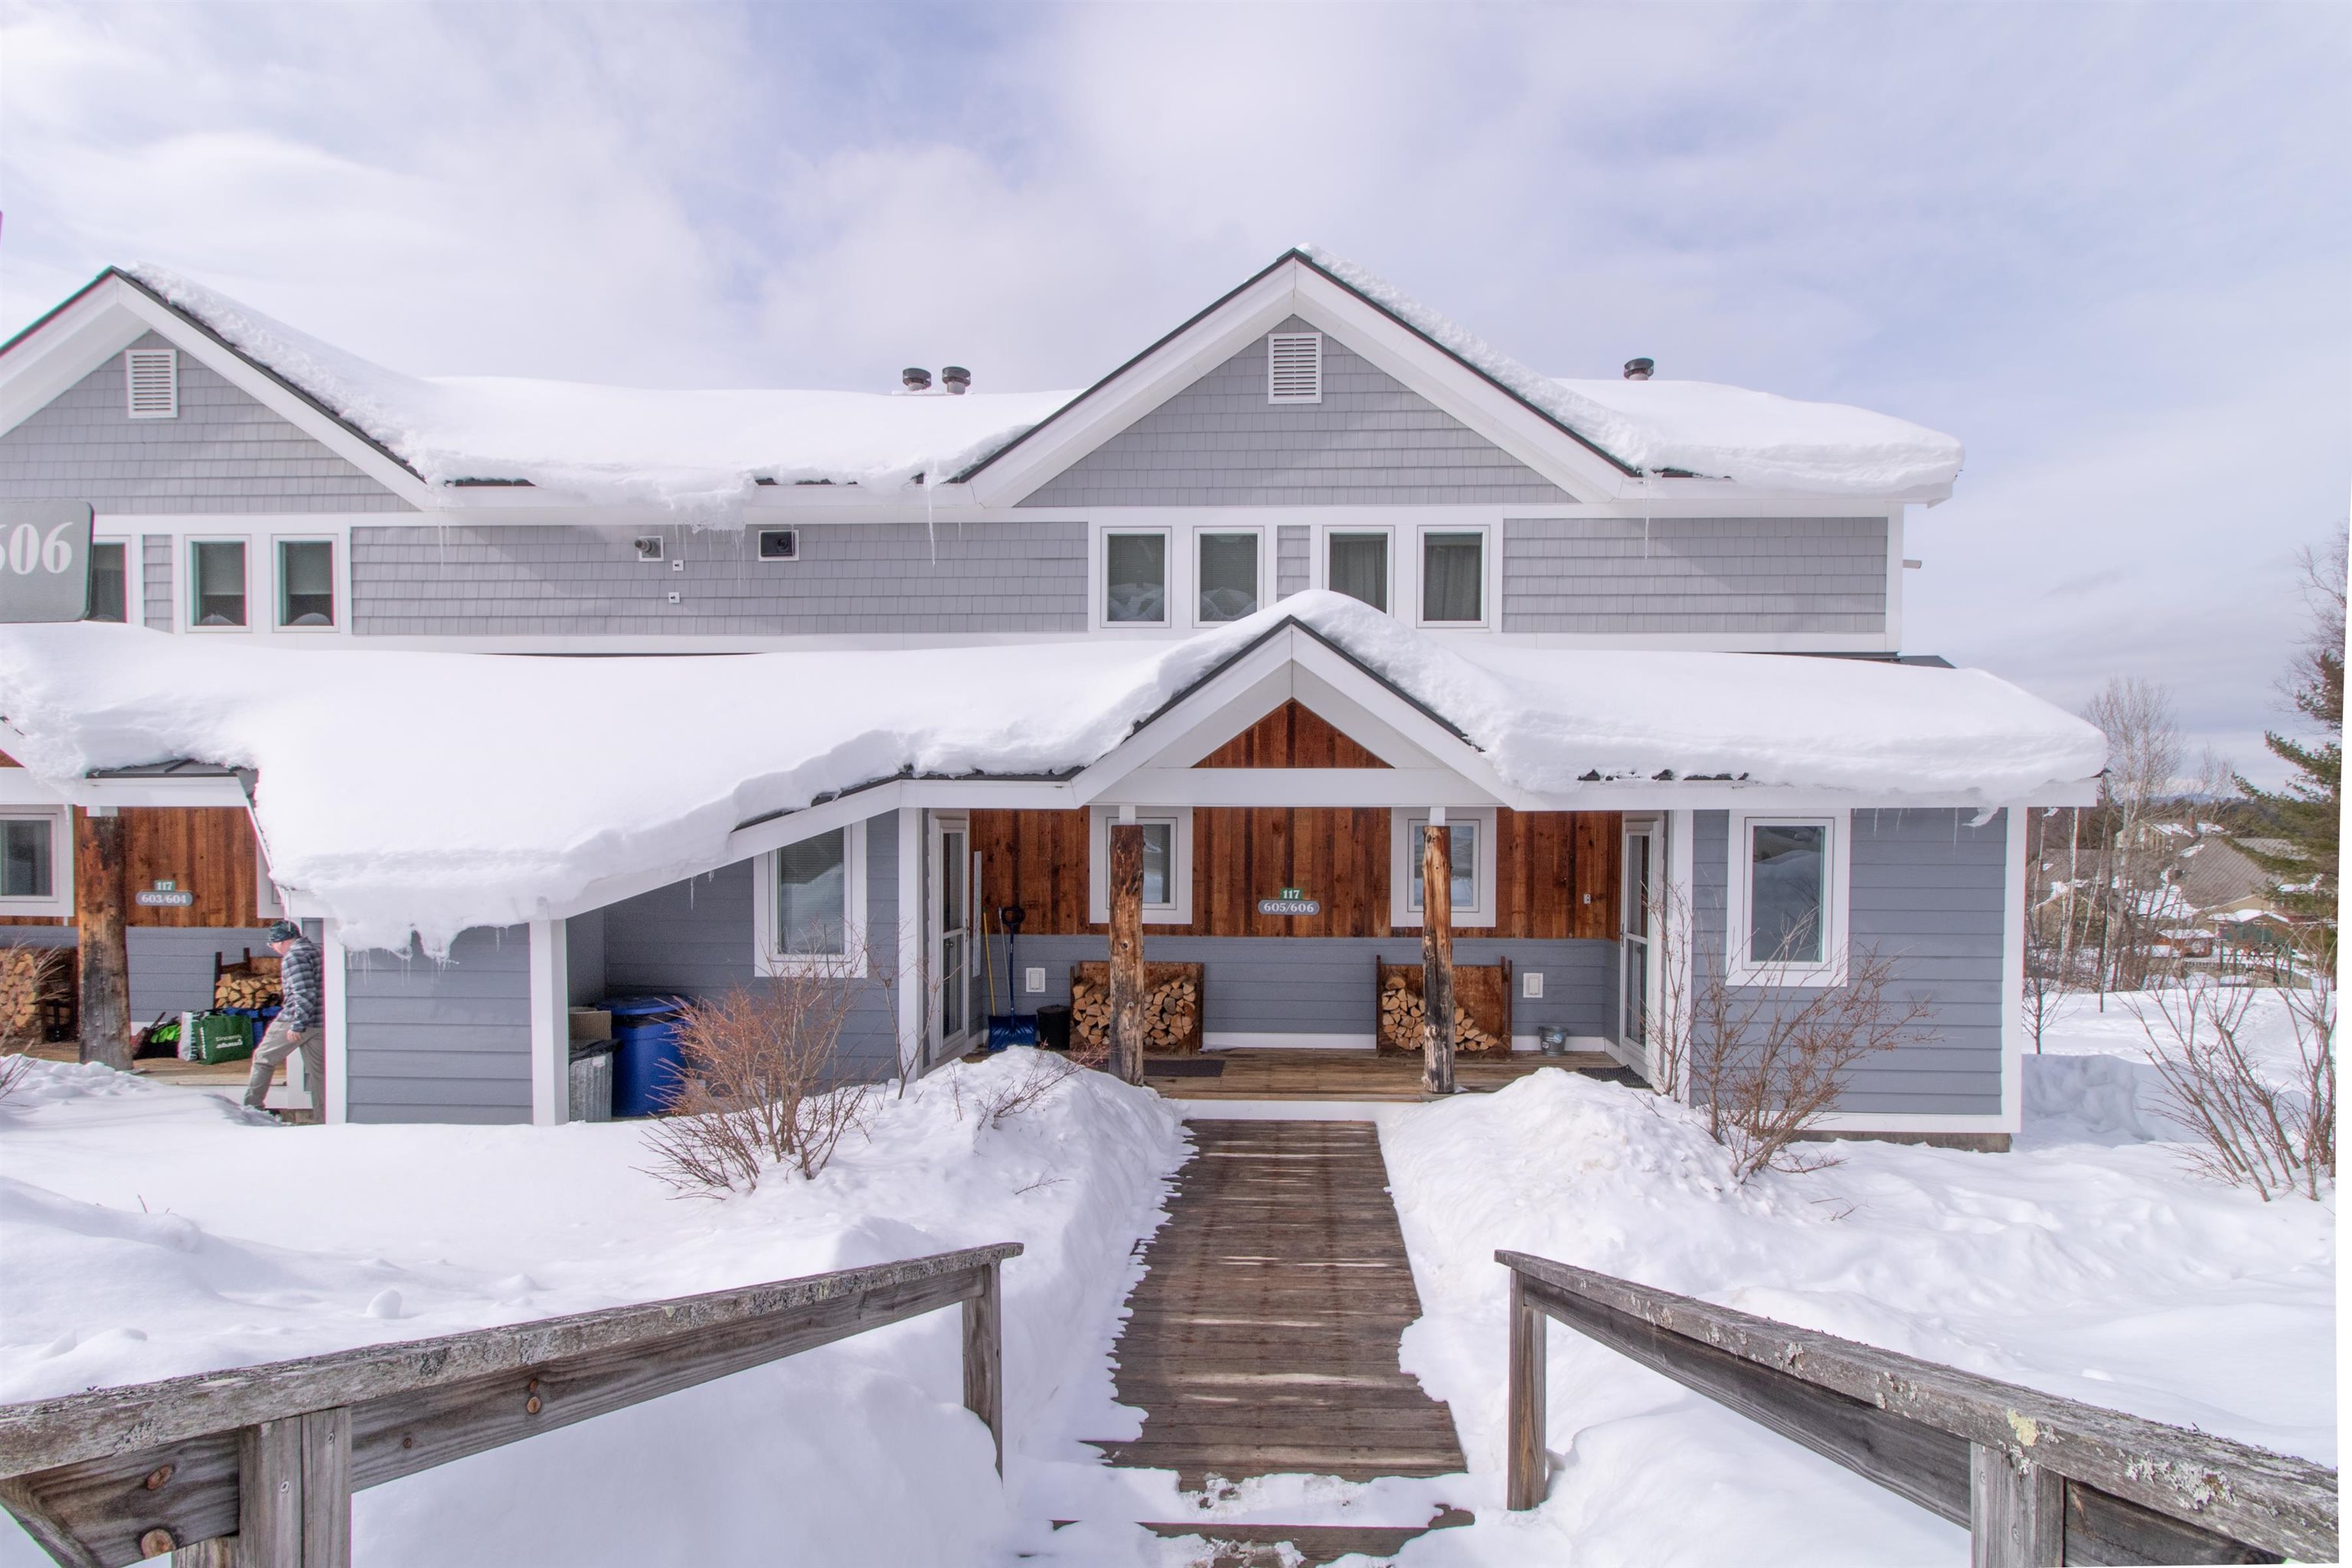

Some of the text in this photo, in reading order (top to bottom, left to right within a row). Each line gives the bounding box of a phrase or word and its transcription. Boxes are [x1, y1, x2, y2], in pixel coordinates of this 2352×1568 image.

[0, 521, 74, 575] 06
[157, 881, 173, 890] 117
[141, 893, 187, 903] 603/604
[1282, 890, 1300, 899] 117
[1263, 903, 1315, 913] 605/606
